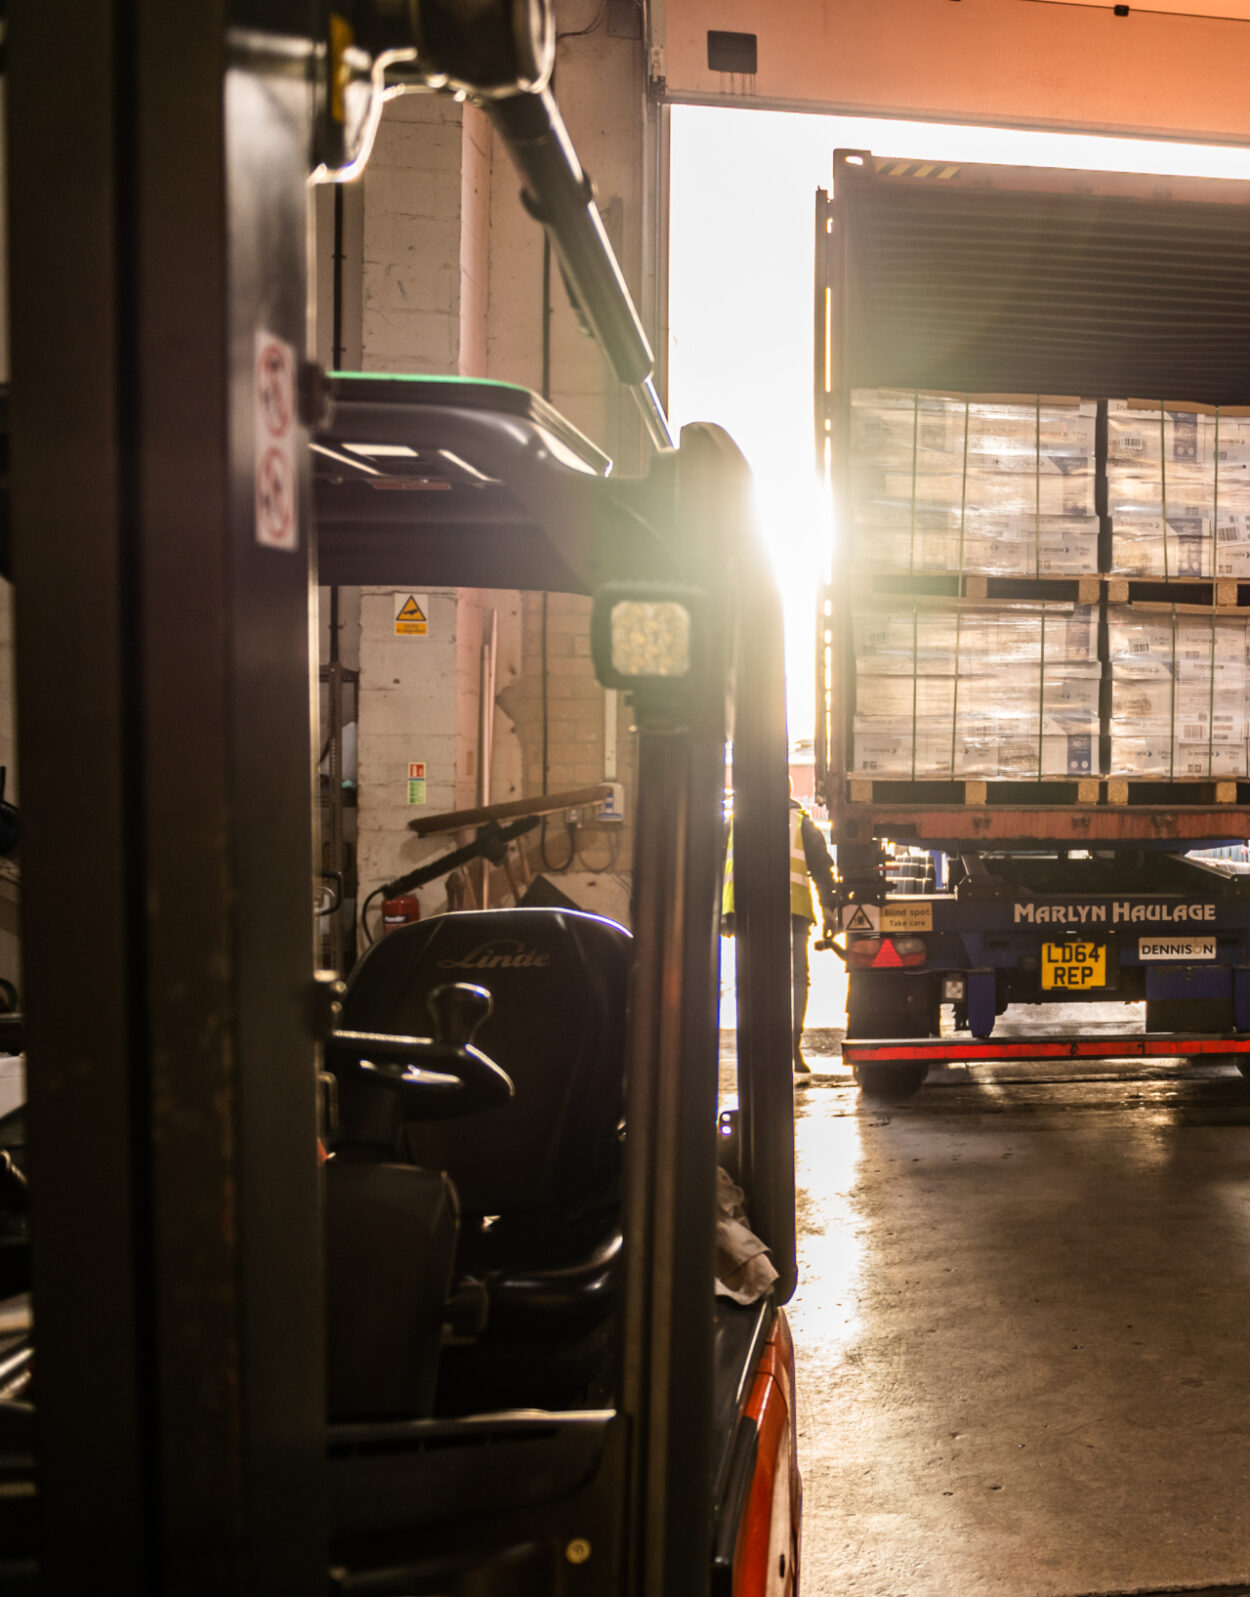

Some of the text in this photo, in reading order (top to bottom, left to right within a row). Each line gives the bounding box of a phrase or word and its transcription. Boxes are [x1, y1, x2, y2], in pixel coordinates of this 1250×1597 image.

[884, 908, 930, 917] Blind spot
[1014, 902, 1216, 924] MARLYN HAULAGE
[437, 939, 550, 969] Linde
[1047, 944, 1100, 963] LD64
[1142, 943, 1214, 955] DENNISON
[1054, 966, 1093, 985] REP
